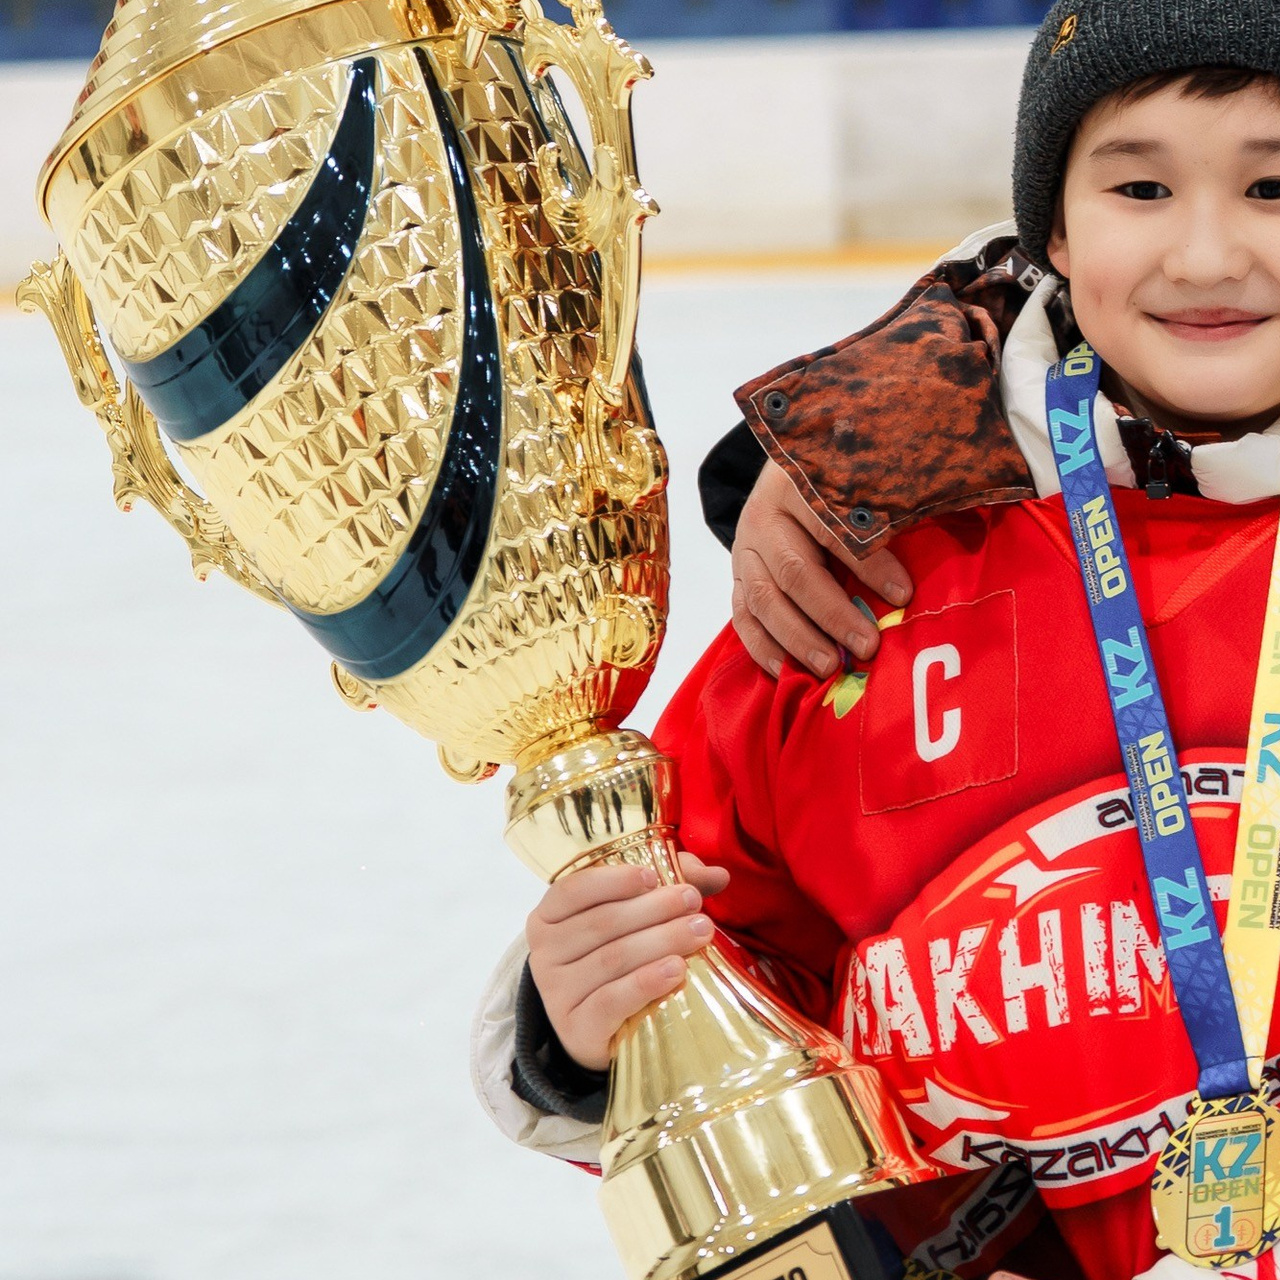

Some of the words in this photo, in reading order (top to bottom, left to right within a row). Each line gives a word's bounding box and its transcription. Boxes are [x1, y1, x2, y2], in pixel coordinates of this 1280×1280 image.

[1049, 398, 1095, 476] KZ
[1083, 494, 1127, 599] OPEN
[912, 643, 962, 763] C
[1101, 625, 1154, 710] KZ
[1138, 730, 1186, 837] OPEN
[1153, 866, 1212, 951] KZ
[1238, 823, 1277, 930] OPEN
[1268, 879, 1280, 929] TOURNAMENT
[1193, 1133, 1262, 1184] KZ
[1193, 1177, 1260, 1204] OPEN
[1213, 1206, 1236, 1248] 1
